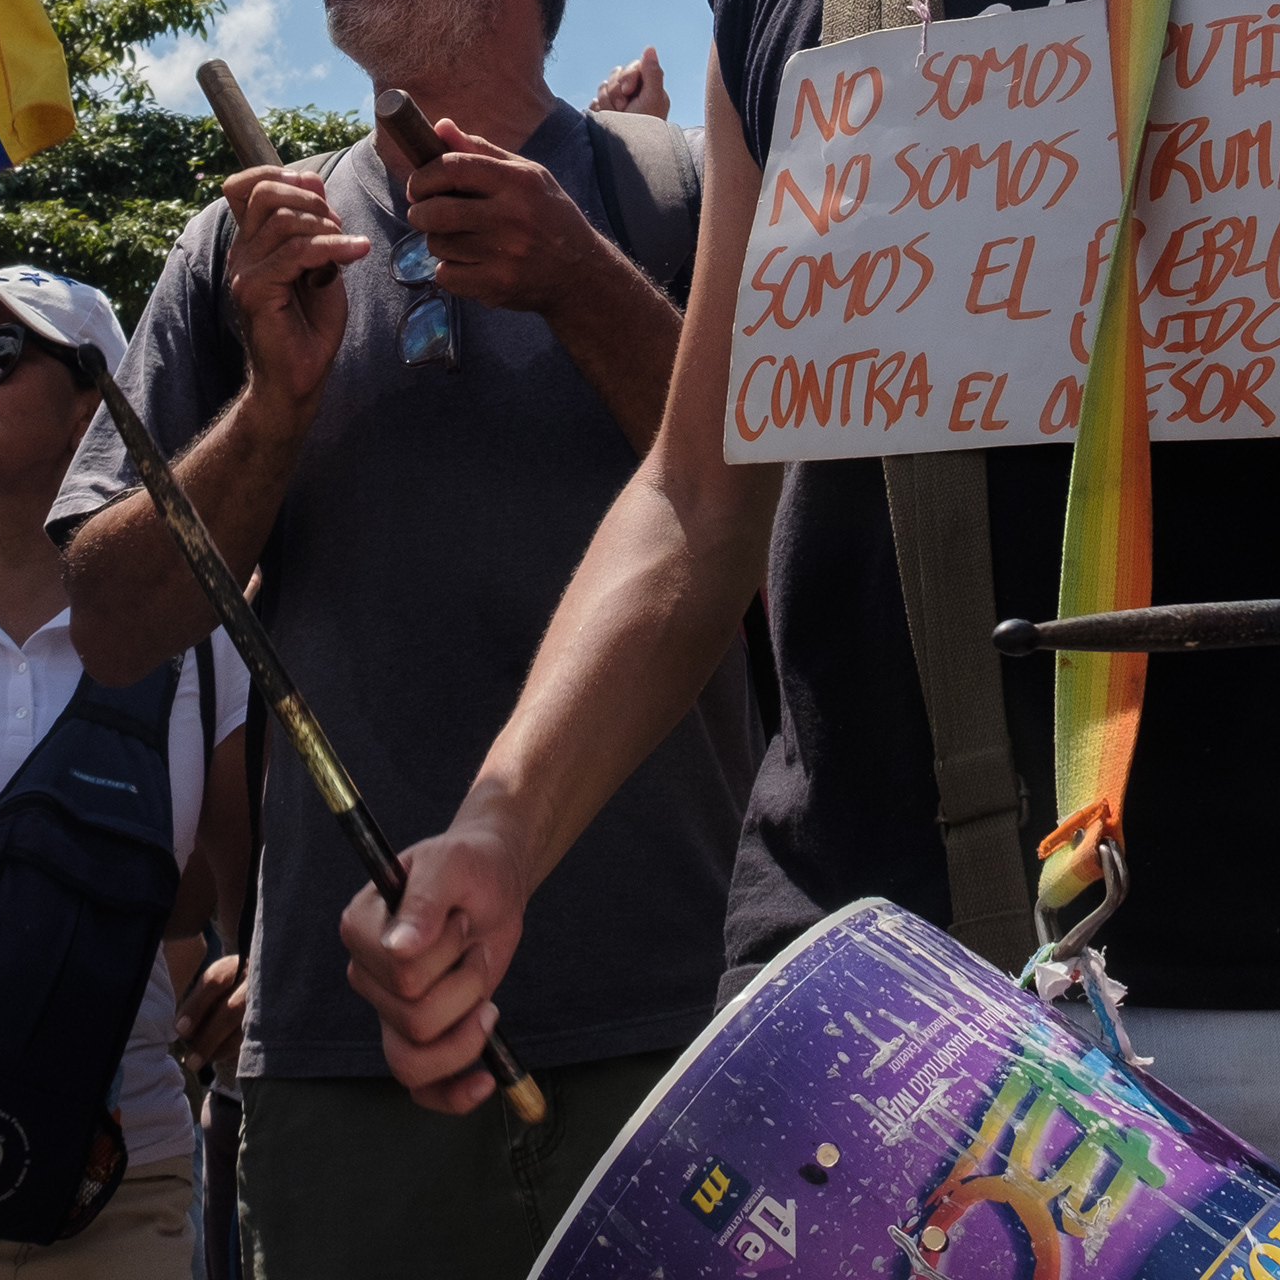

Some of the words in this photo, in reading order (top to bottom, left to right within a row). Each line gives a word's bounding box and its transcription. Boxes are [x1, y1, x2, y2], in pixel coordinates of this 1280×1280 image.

[790, 66, 883, 142] NO
[915, 34, 1092, 121] SOMOS
[769, 153, 871, 236] NO
[888, 129, 1080, 214] SOMOS
[742, 232, 934, 336] SOMOS
[966, 235, 1051, 320] EL
[735, 348, 933, 441] CONTRA
[948, 371, 1009, 432] EL
[1039, 356, 1276, 435] OESOR
[887, 1040, 921, 1074] Exterior
[868, 1088, 919, 1140] MATE
[691, 1164, 731, 1214] m
[742, 1184, 766, 1213] INTERIOR
[717, 1215, 742, 1246] EXTERIOR
